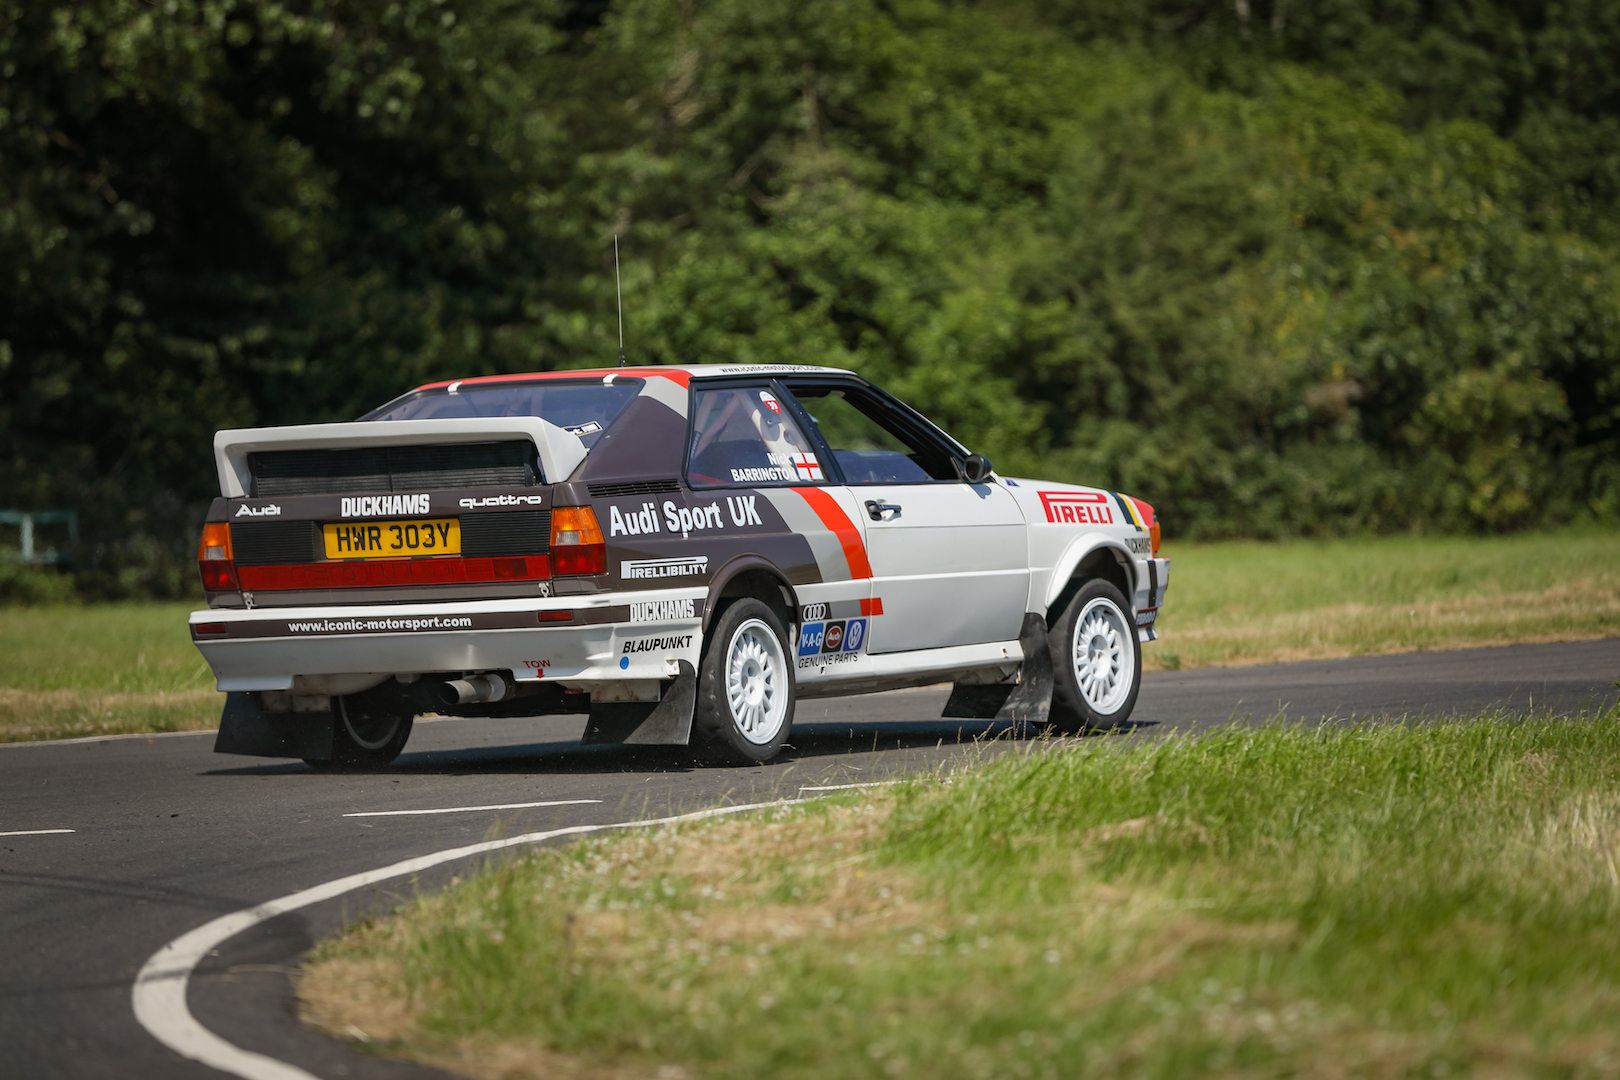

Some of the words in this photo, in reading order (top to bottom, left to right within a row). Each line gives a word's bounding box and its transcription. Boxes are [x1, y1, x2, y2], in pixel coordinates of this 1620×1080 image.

[730, 468, 797, 482] BARRINGTON
[235, 504, 281, 517] Audi
[341, 494, 430, 517] DUCKHAMS
[459, 495, 542, 508] quattro
[1037, 491, 1114, 524] PIRELLI
[610, 502, 660, 537] Audi
[662, 500, 723, 539] Sport
[727, 496, 763, 527] UK
[337, 526, 382, 551] HWR
[390, 522, 451, 549] 303Y
[621, 556, 708, 579] PIRELLIBILITY
[629, 599, 695, 622] DUCKHAMS
[288, 616, 472, 632] www.iconic-motorsport.com
[622, 635, 693, 653] BLAUPUNKT
[524, 659, 551, 669] TOW
[798, 654, 833, 669] GENUINE
[834, 651, 858, 664] PARTS
